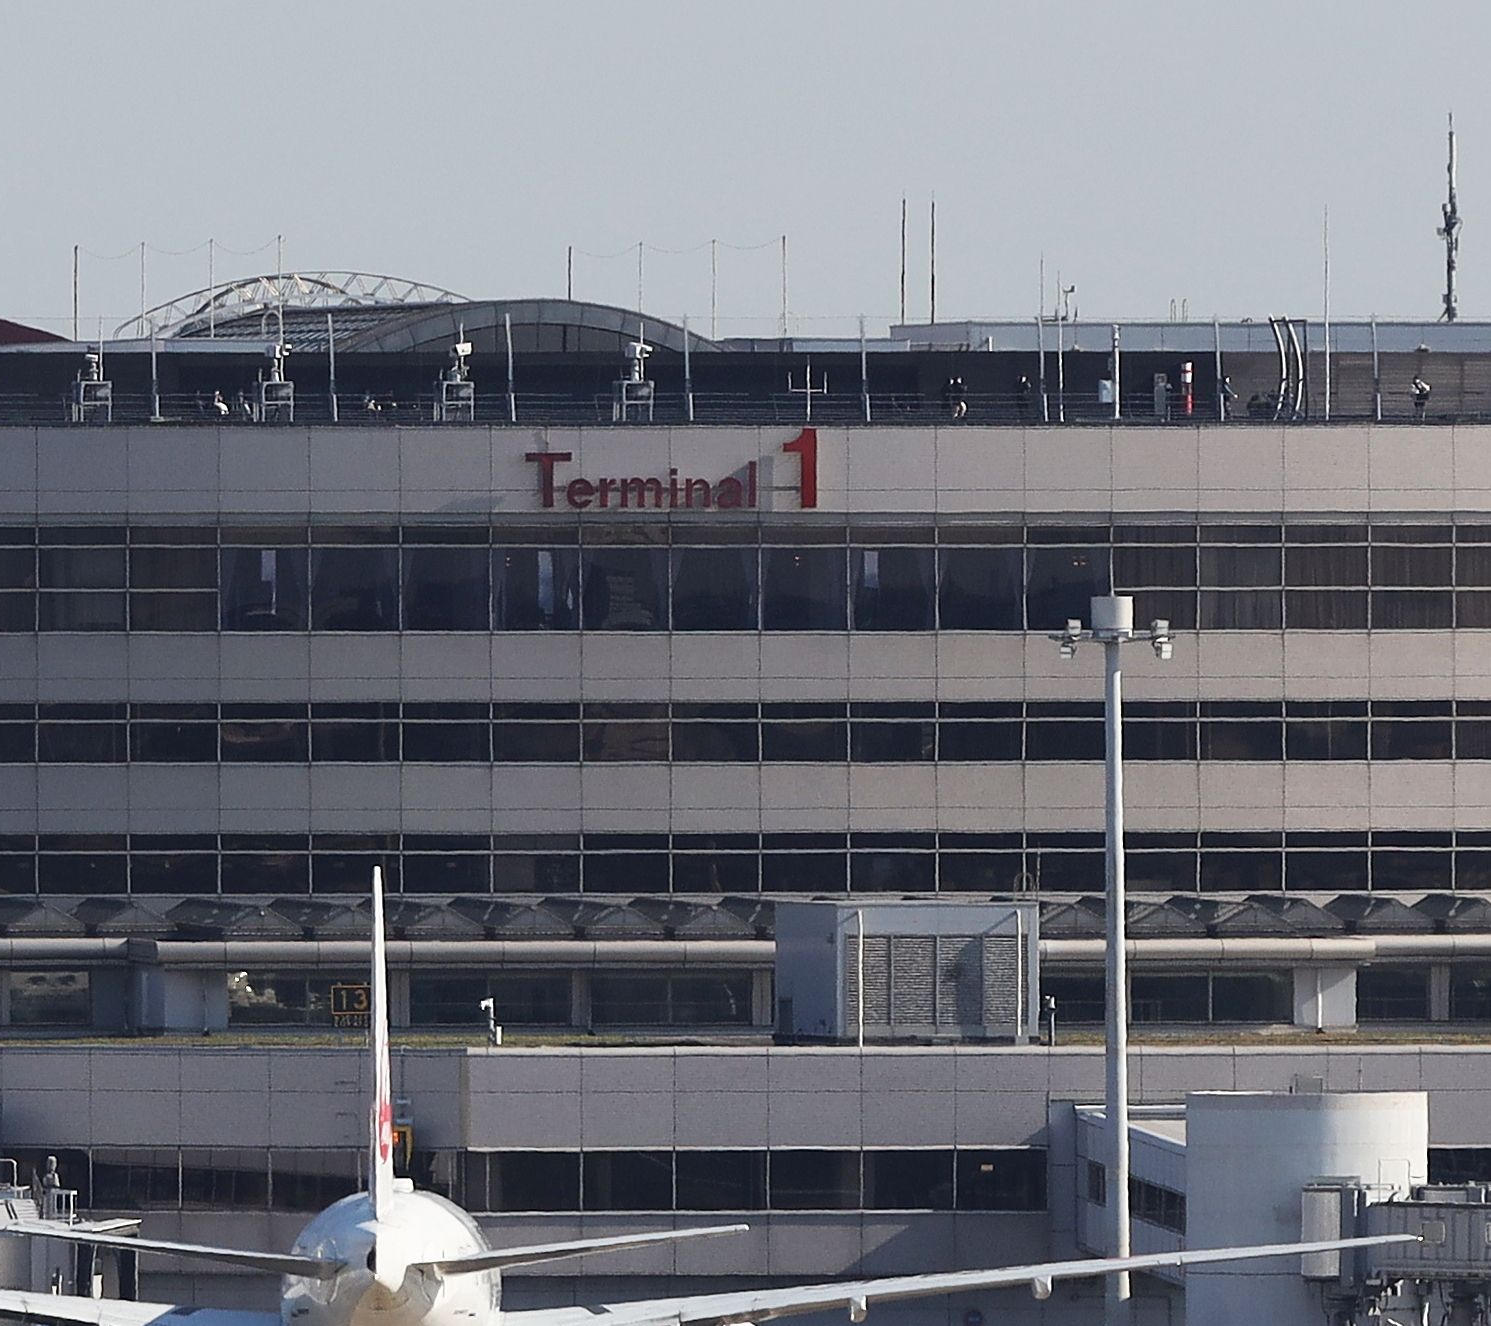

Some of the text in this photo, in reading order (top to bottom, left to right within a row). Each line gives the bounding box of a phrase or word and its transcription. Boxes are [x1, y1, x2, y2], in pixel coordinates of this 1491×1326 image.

[525, 428, 817, 508] Terminal 1
[340, 989, 368, 1010] 13
